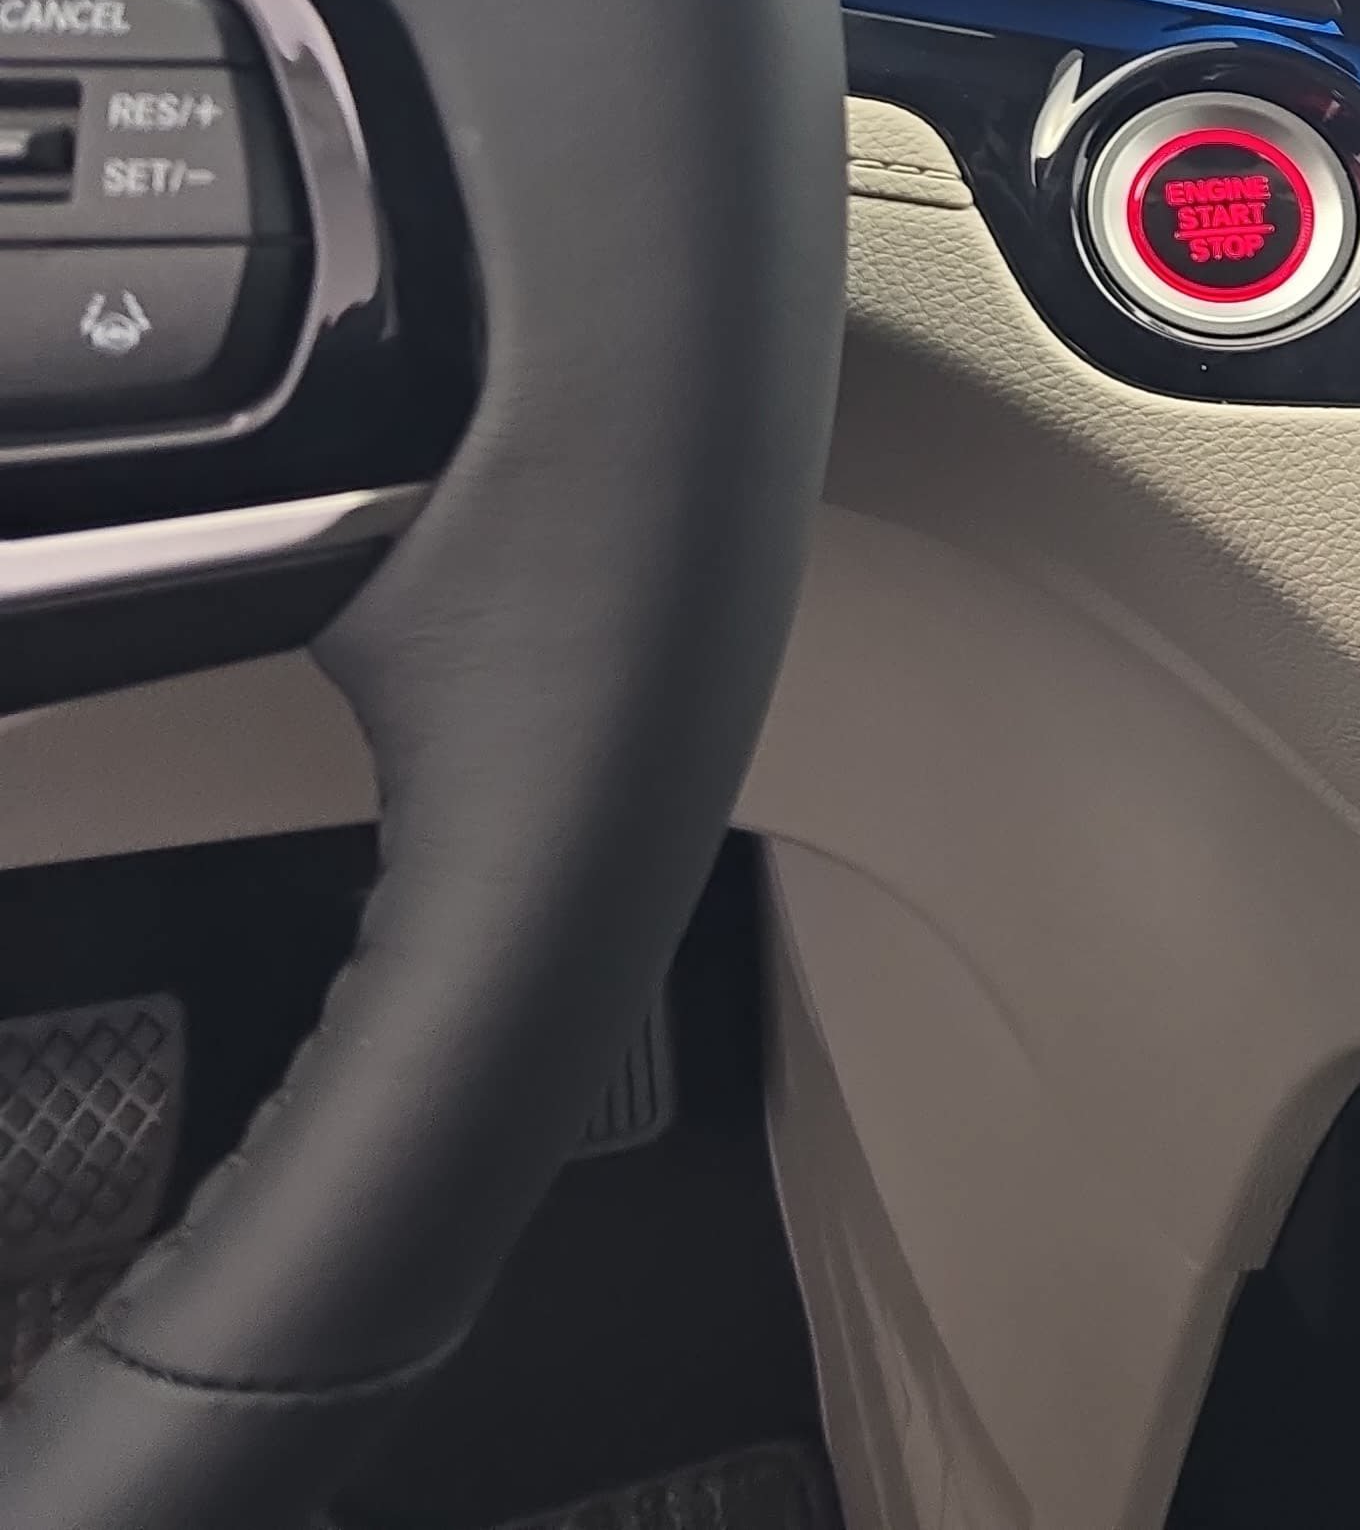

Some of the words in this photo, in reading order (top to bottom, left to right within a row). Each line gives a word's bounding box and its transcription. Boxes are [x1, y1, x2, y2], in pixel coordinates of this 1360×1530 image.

[1165, 175, 1271, 205] ENGINE
[1178, 203, 1267, 230] START
[1187, 233, 1266, 262] STOP
